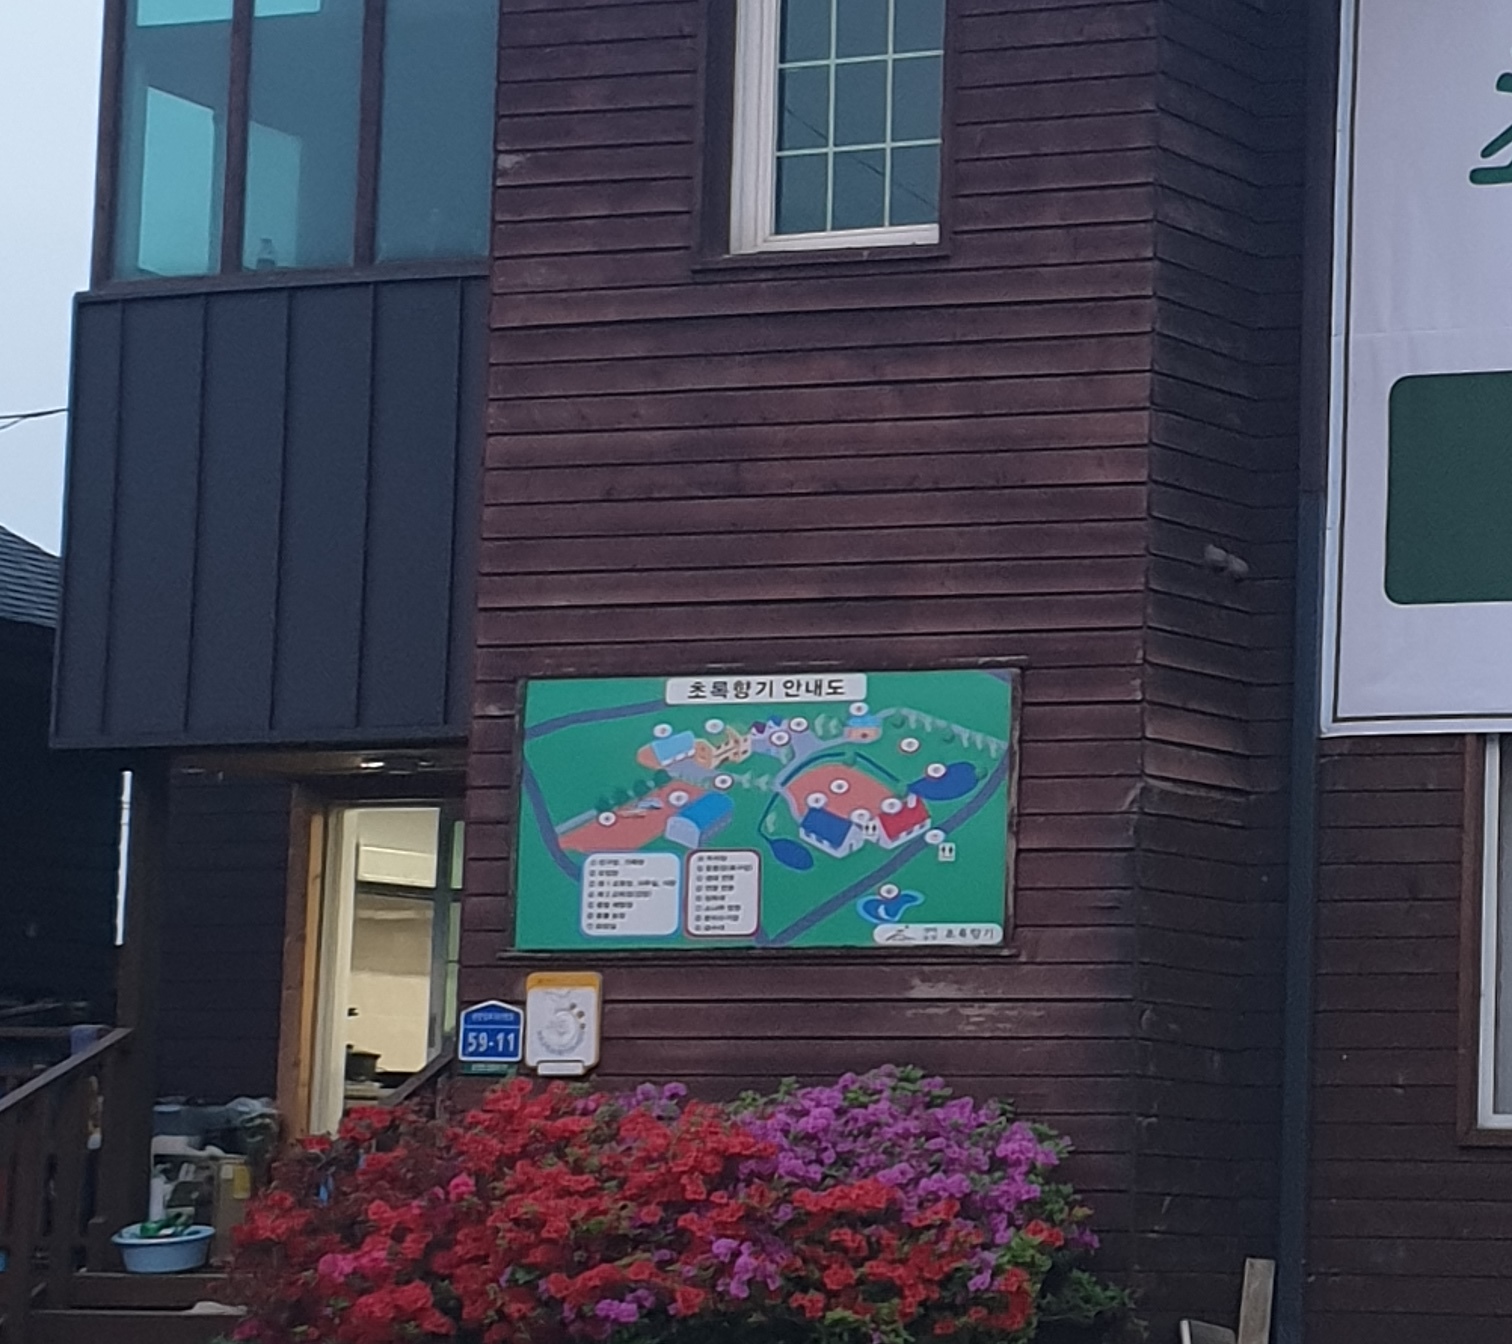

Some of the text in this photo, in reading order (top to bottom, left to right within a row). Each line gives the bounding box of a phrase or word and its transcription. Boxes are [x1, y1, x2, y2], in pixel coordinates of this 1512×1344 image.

[688, 679, 845, 699] 초록향기 안내도
[468, 1032, 515, 1052] 59-11
